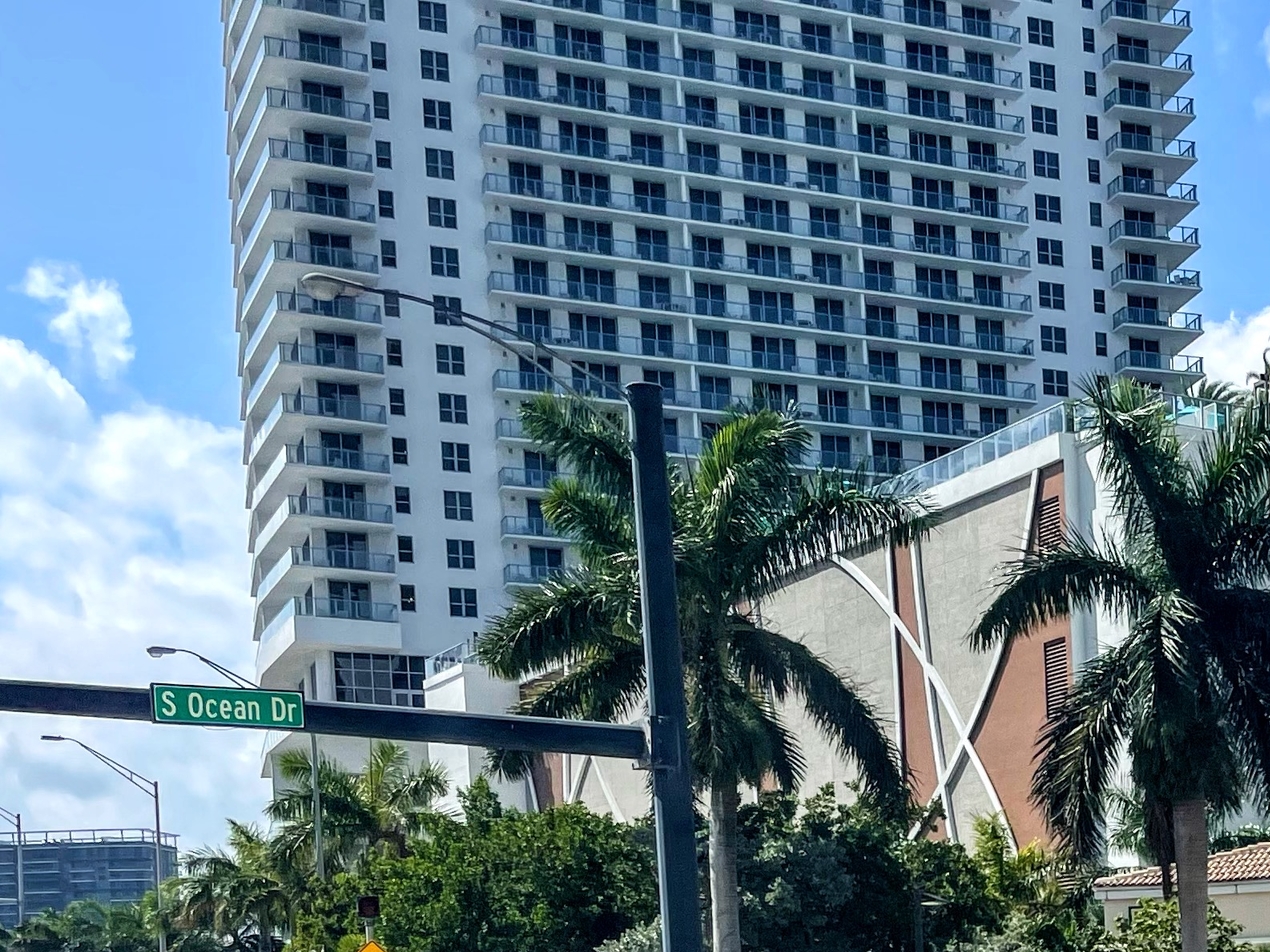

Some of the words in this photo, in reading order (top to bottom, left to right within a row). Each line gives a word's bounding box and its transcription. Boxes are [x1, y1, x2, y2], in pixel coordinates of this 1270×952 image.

[161, 690, 177, 717] S
[187, 692, 261, 721] Ocean
[271, 696, 297, 723] Dr
